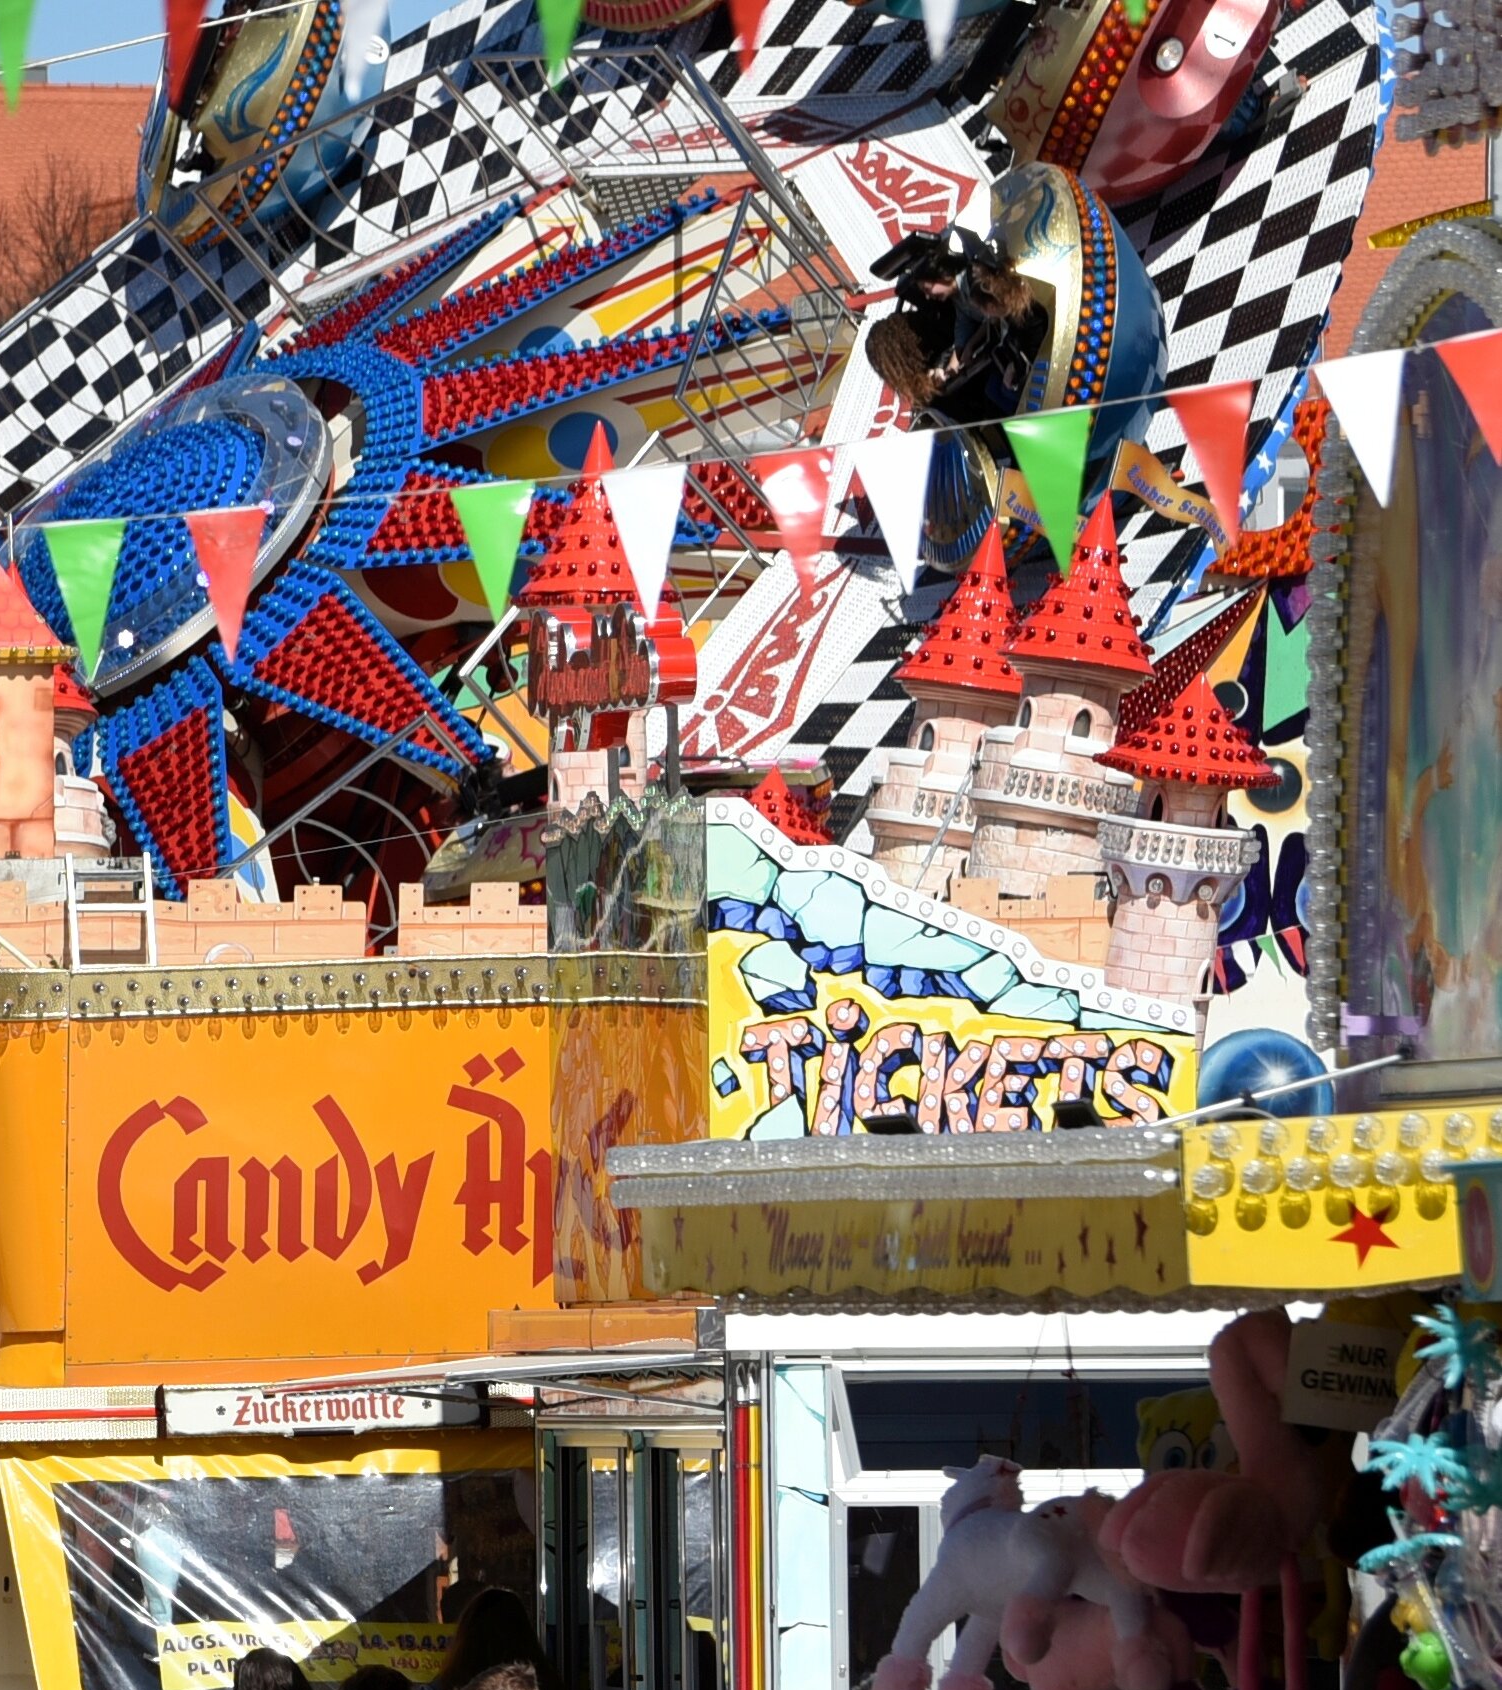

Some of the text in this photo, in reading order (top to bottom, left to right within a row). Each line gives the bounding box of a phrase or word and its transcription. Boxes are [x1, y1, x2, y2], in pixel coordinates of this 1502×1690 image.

[97, 1093, 435, 1293] Candy
[1339, 1343, 1388, 1368] NUR
[1300, 1368, 1399, 1400] GEWINN
[233, 1391, 406, 1427] Zuckerwatte
